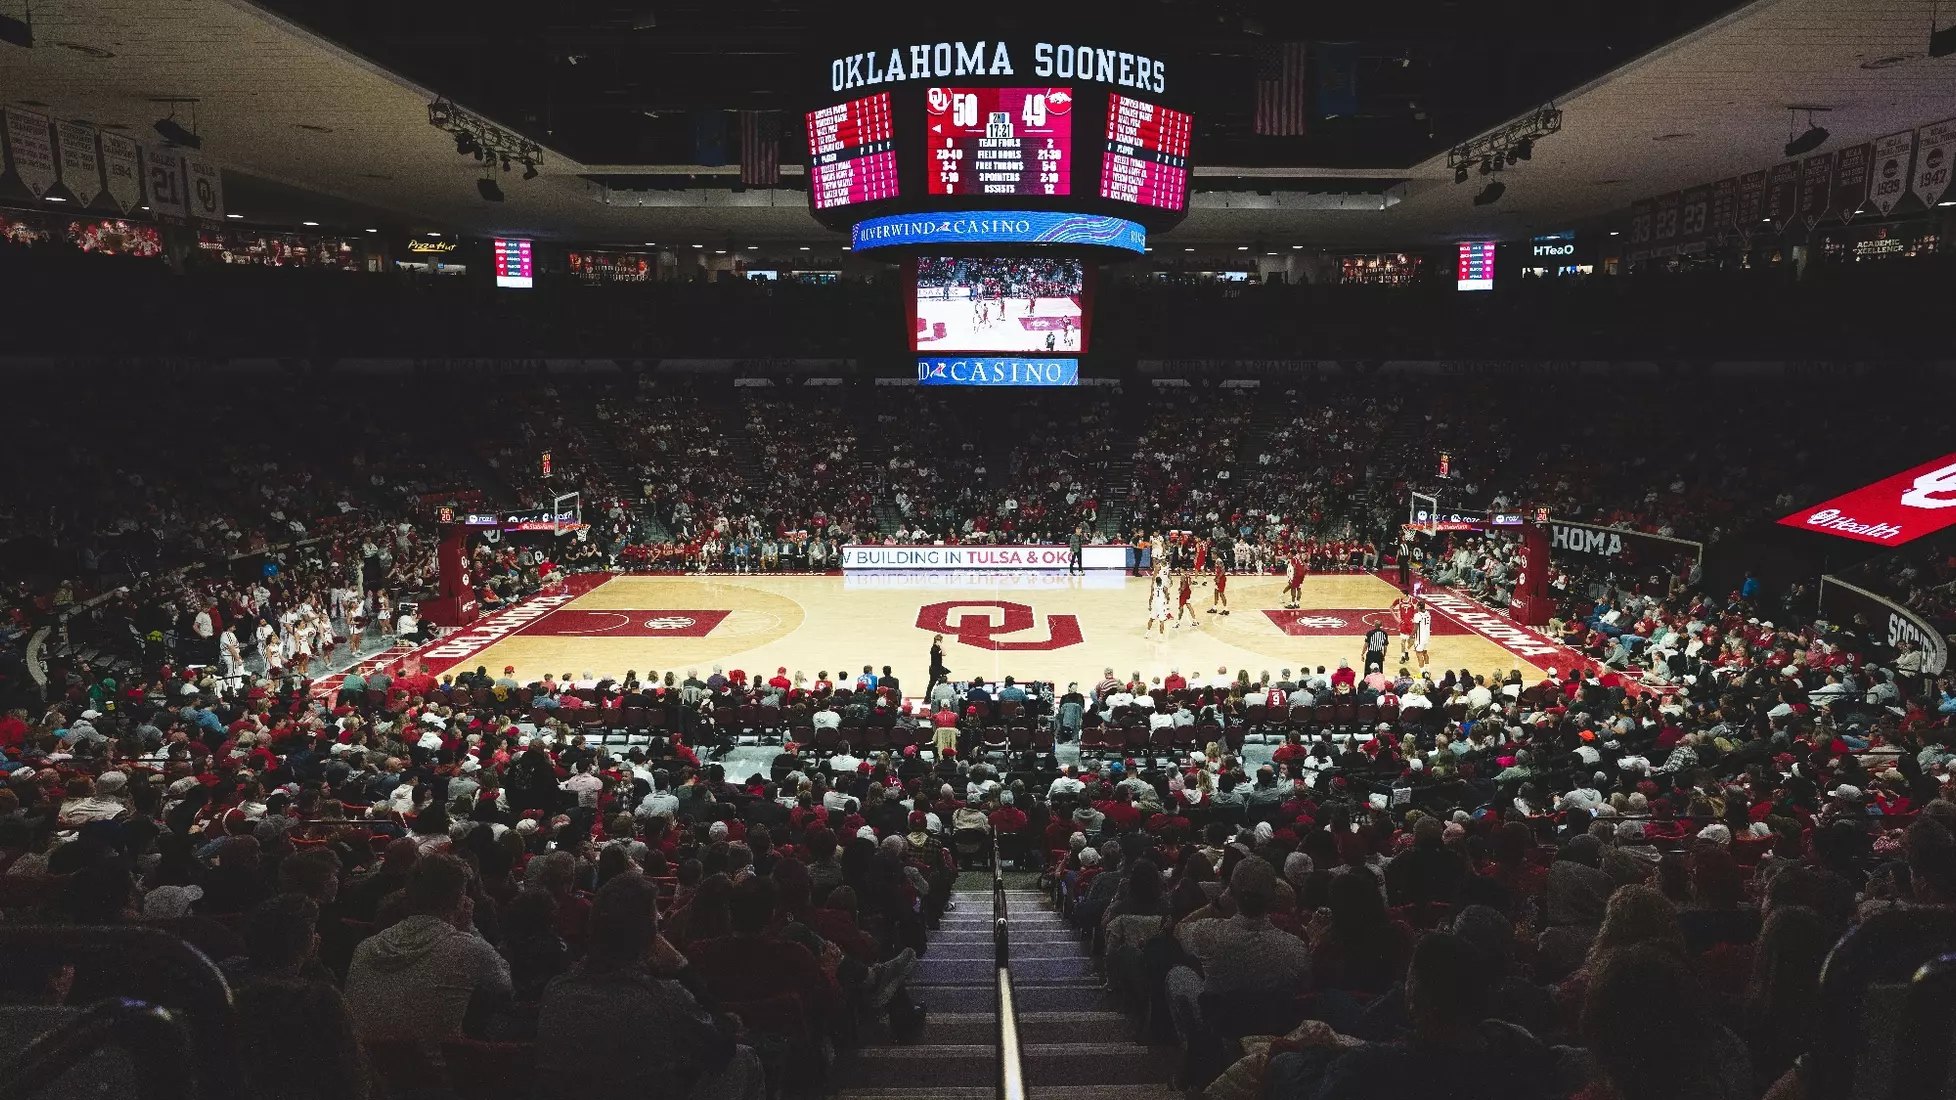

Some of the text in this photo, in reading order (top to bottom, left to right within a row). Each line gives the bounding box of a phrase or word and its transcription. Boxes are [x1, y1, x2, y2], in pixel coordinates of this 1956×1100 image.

[832, 41, 1164, 93] OKLAHOMA SOONERS
[953, 93, 978, 126] 50
[1022, 94, 1046, 127] 49
[989, 124, 1011, 138] 17:21
[979, 139, 997, 147] TEAM
[151, 167, 181, 205] 21
[1920, 169, 1948, 188] 1947
[984, 185, 1015, 193] ASSISTS
[953, 220, 1030, 234] CASINO
[408, 240, 457, 251] Pizza Hut
[1533, 244, 1574, 256] HTeaO
[1856, 239, 1900, 248] ACADEMIC
[950, 361, 1062, 382] CASINO
[1821, 516, 1902, 539] Health
[1551, 525, 1622, 556] HOMA
[857, 551, 939, 564] BUILDING
[945, 551, 961, 564] IN
[967, 551, 1022, 564] TULSA
[1026, 551, 1039, 564] &
[915, 601, 1084, 650] OU
[1417, 594, 1559, 656] OKLAHOMA
[1272, 693, 1280, 706] 9
